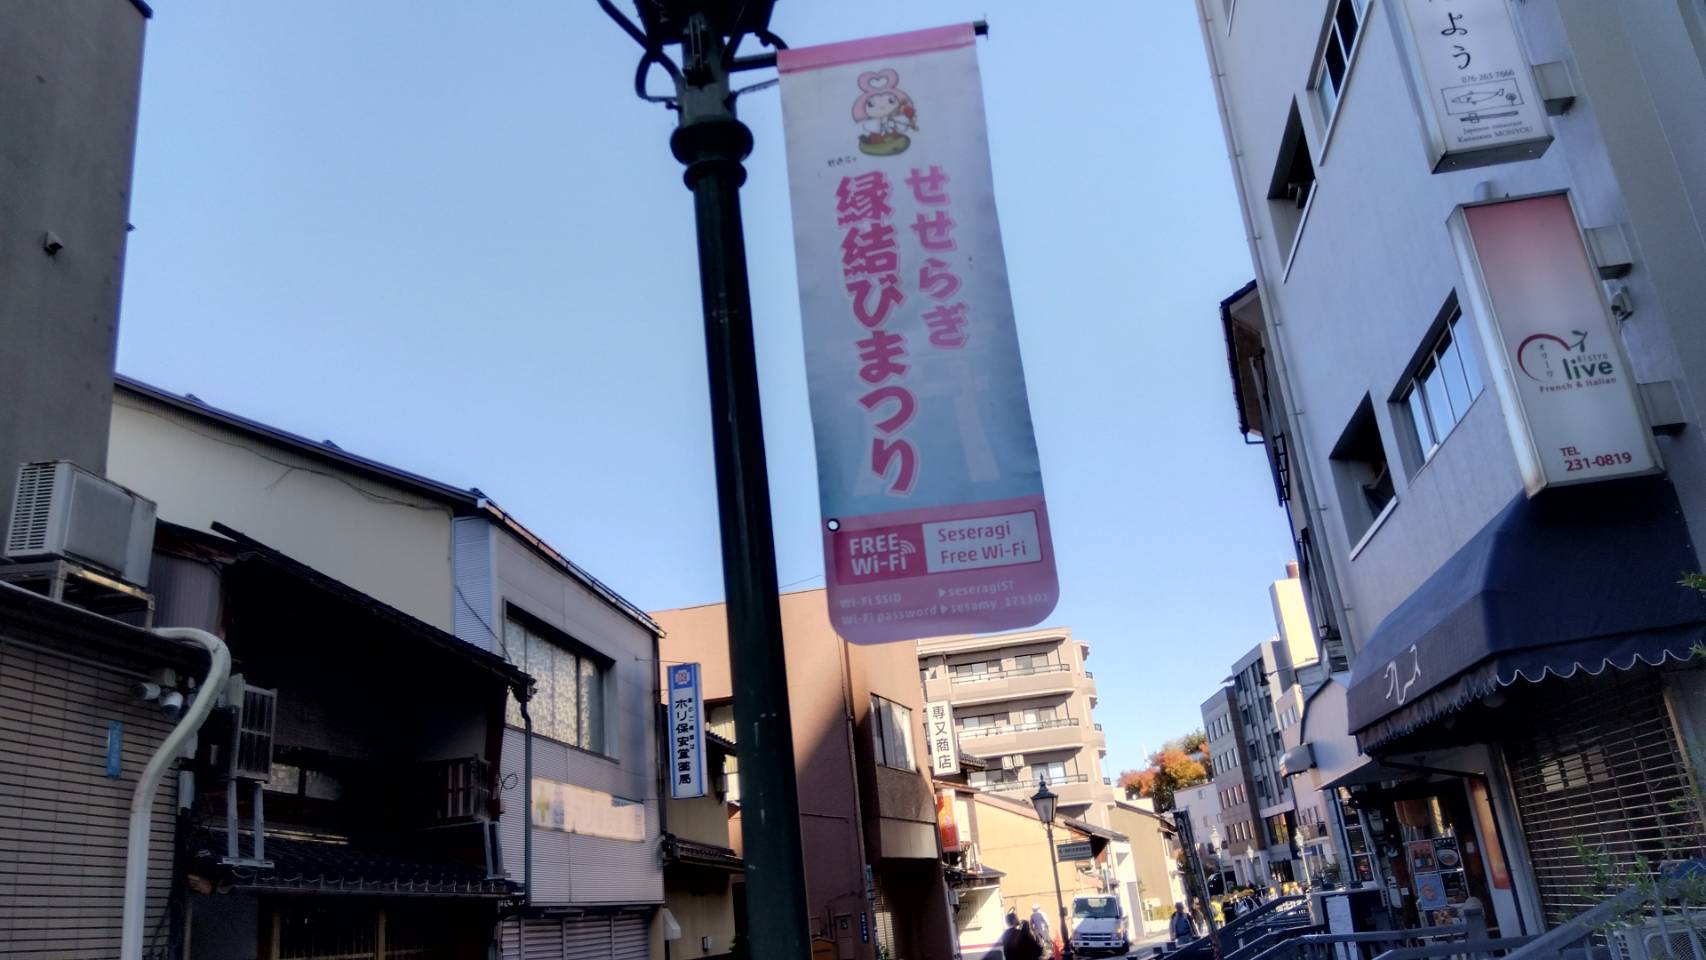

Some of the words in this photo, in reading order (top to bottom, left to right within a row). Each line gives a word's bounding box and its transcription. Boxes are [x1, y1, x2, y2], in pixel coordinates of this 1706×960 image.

[905, 165, 970, 348] せせらぎ
[835, 170, 918, 495] 縁結びまつり
[1560, 446, 1580, 457] TEL
[1564, 451, 1633, 472] 231-0819
[938, 521, 1011, 543] Seseragi
[849, 533, 899, 556] FREE
[940, 548, 977, 565] Free
[982, 541, 1027, 560] Wi-Fi
[851, 553, 907, 576] Wi-Fi
[877, 605, 937, 623] password
